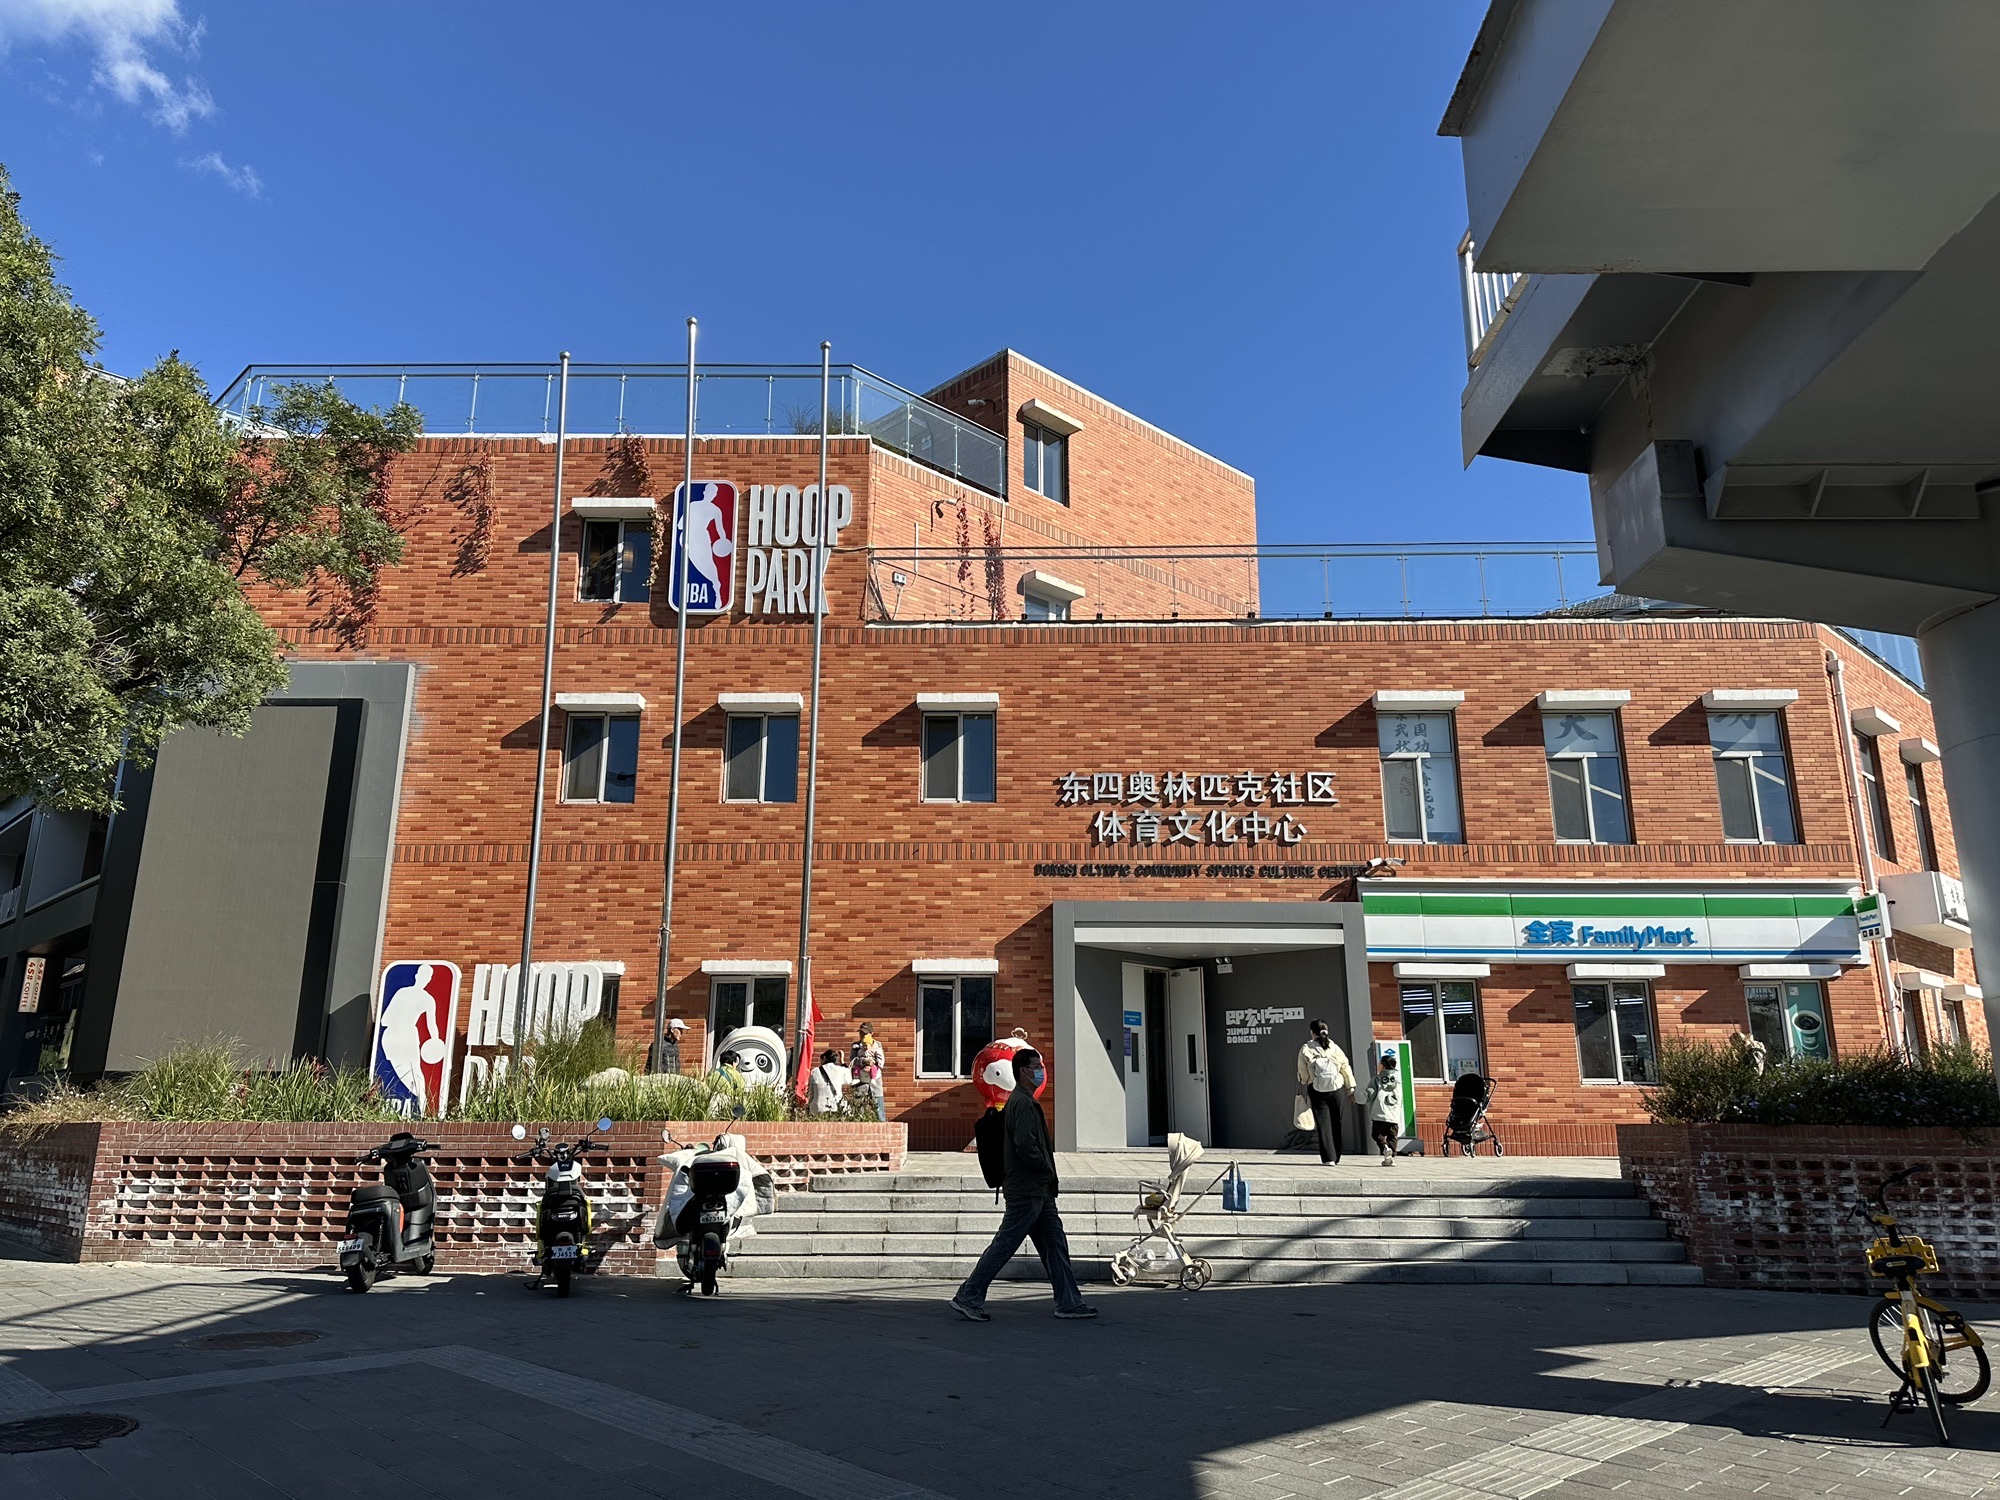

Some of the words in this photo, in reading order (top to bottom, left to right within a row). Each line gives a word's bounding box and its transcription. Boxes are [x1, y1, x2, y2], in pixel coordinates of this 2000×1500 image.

[748, 484, 852, 547] HOOP
[1058, 770, 1338, 804] 东四奥林匹克社区
[1093, 809, 1308, 844] 体育文化中心
[1034, 864, 1077, 877] DONGSI
[1080, 864, 1131, 877] OLYMPIC
[1134, 864, 1202, 877] COMMUNITY
[1205, 864, 1256, 878] SPORTS
[1258, 864, 1316, 878] CULTURE
[1525, 920, 1575, 943] 全家
[1582, 925, 1694, 952] FamilyMart
[21, 982, 31, 1008] COFFEE
[1226, 1027, 1249, 1036] JUMP
[1250, 1027, 1262, 1035] ON
[1263, 1026, 1272, 1034] IT
[1226, 1035, 1257, 1044] DONGSI
